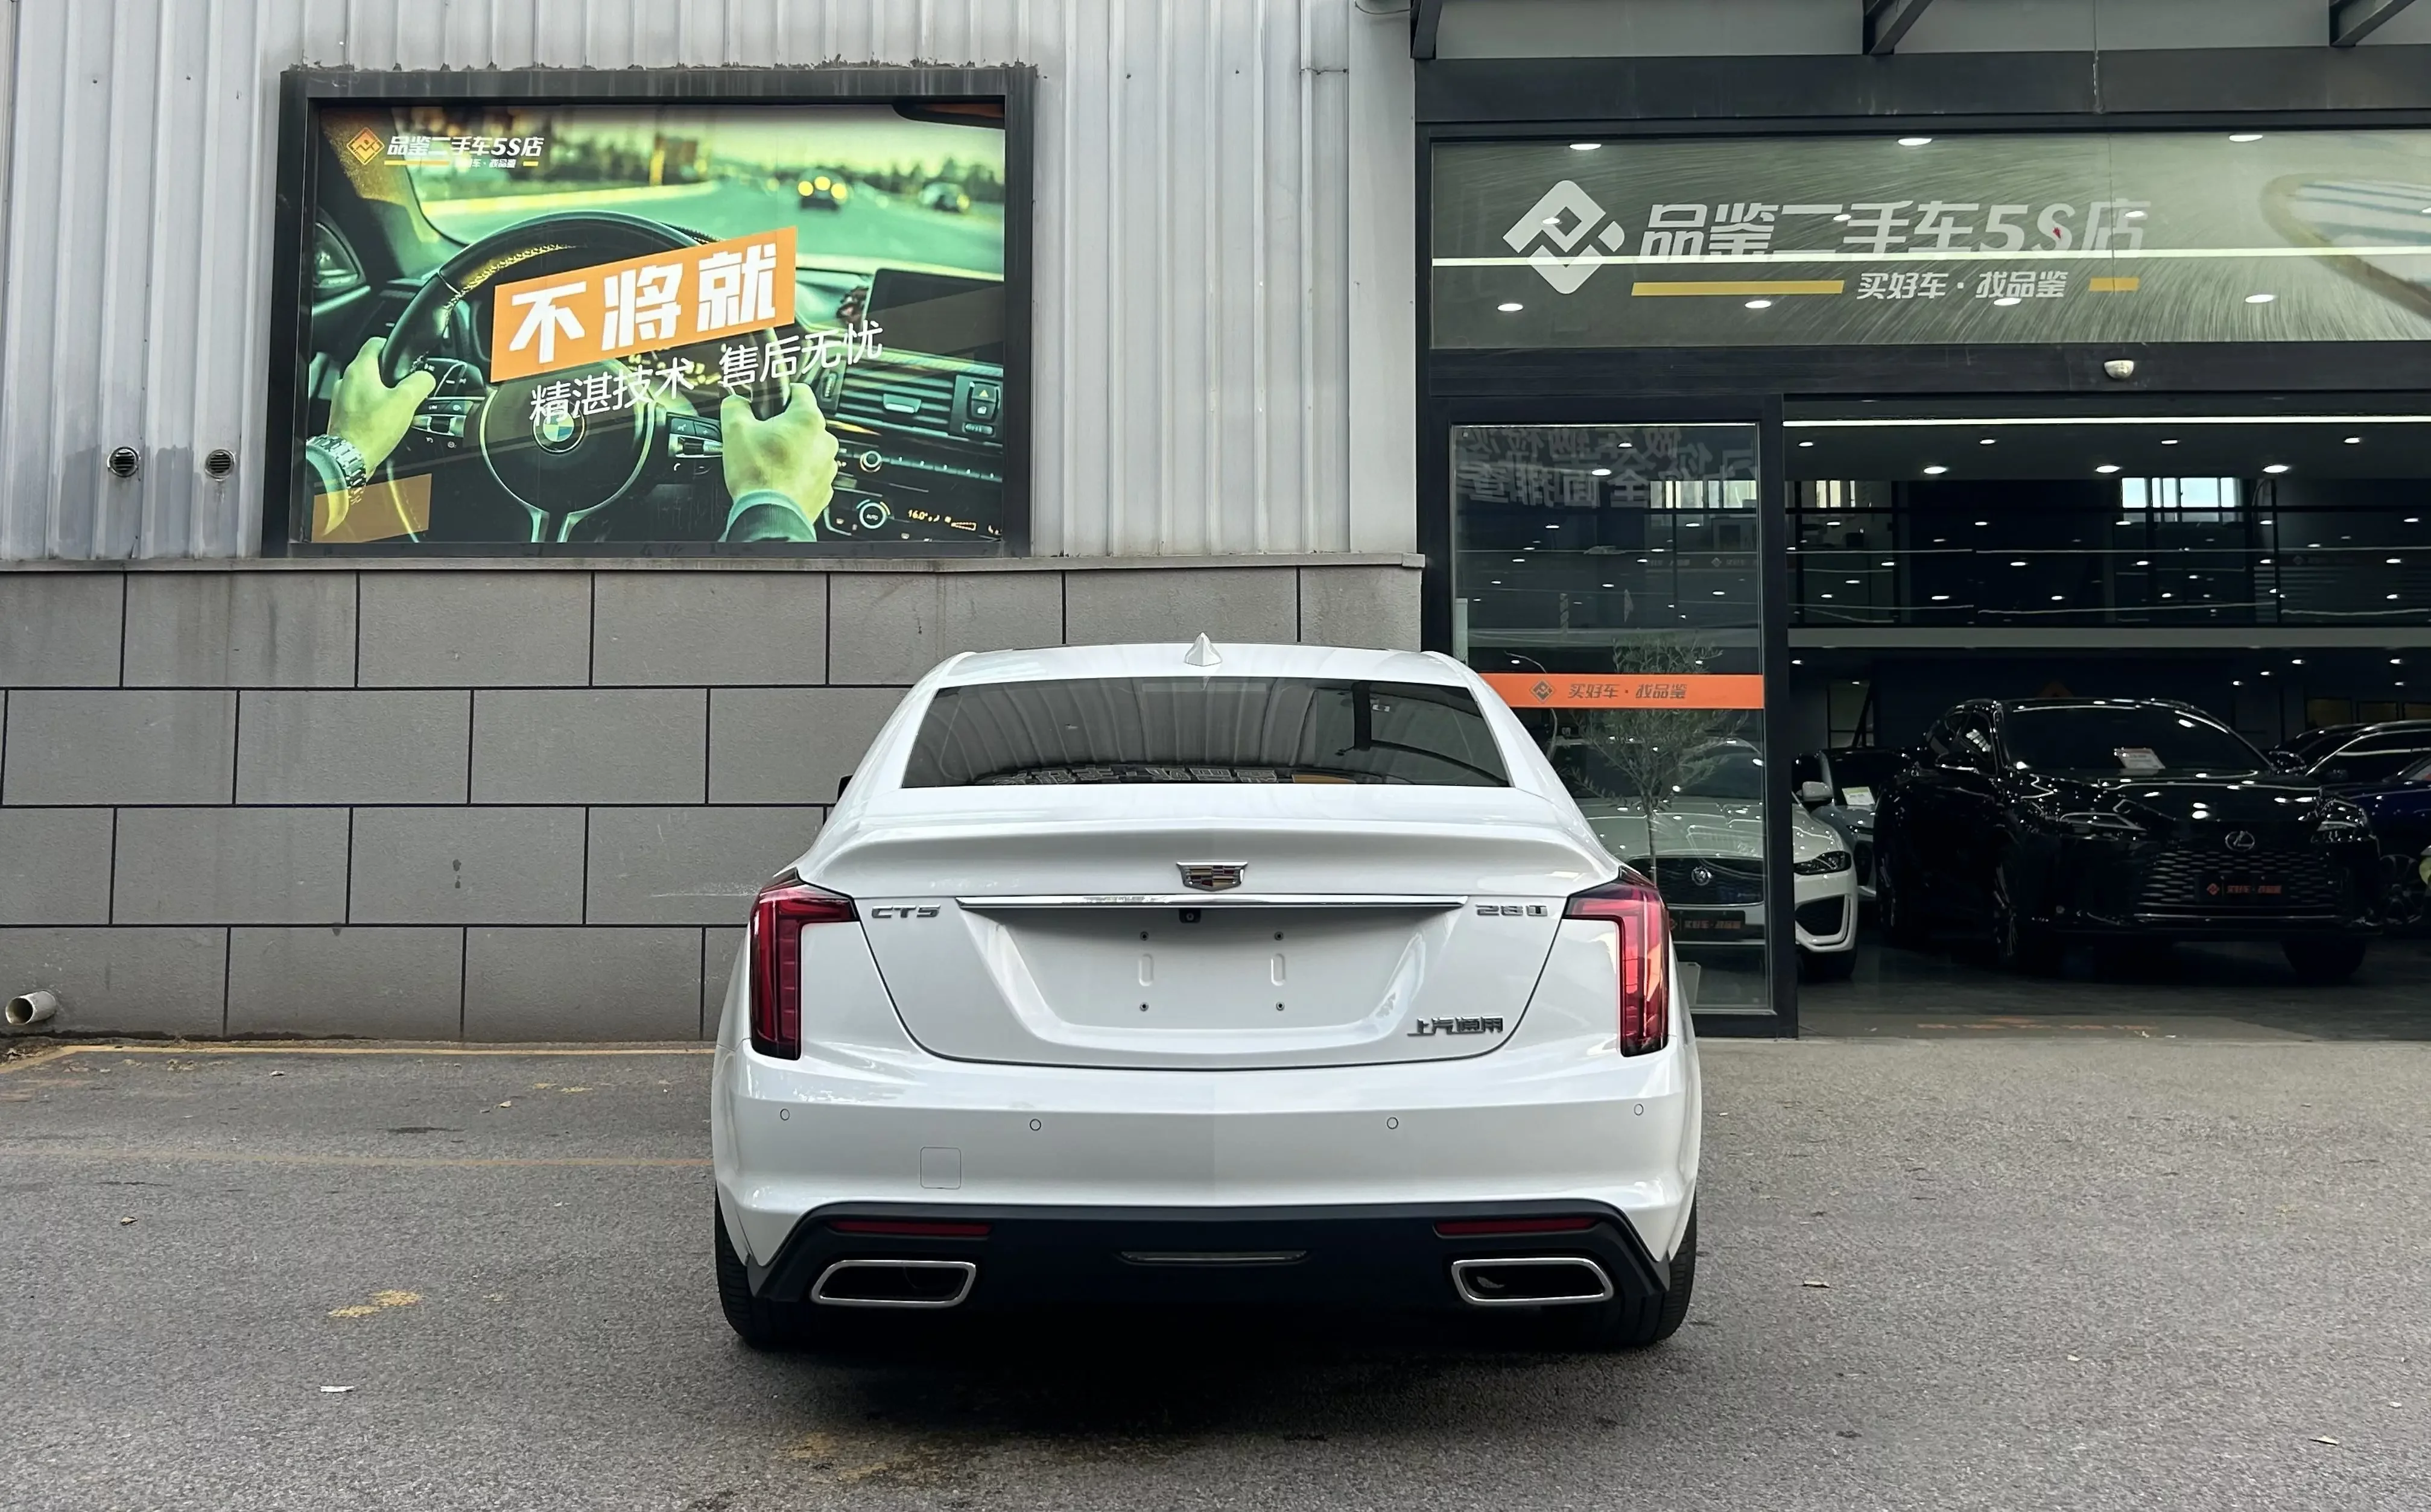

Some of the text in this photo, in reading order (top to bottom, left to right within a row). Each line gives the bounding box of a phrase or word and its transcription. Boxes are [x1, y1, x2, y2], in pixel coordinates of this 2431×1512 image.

[387, 136, 544, 157] 品鉴二手车5S店
[1638, 198, 2152, 261] 品鉴二手车5S店
[509, 243, 777, 364] 不将就
[719, 320, 883, 388] 售后无忧
[530, 357, 694, 426] 精湛技术
[1407, 1015, 1504, 1036] 上汽通用
